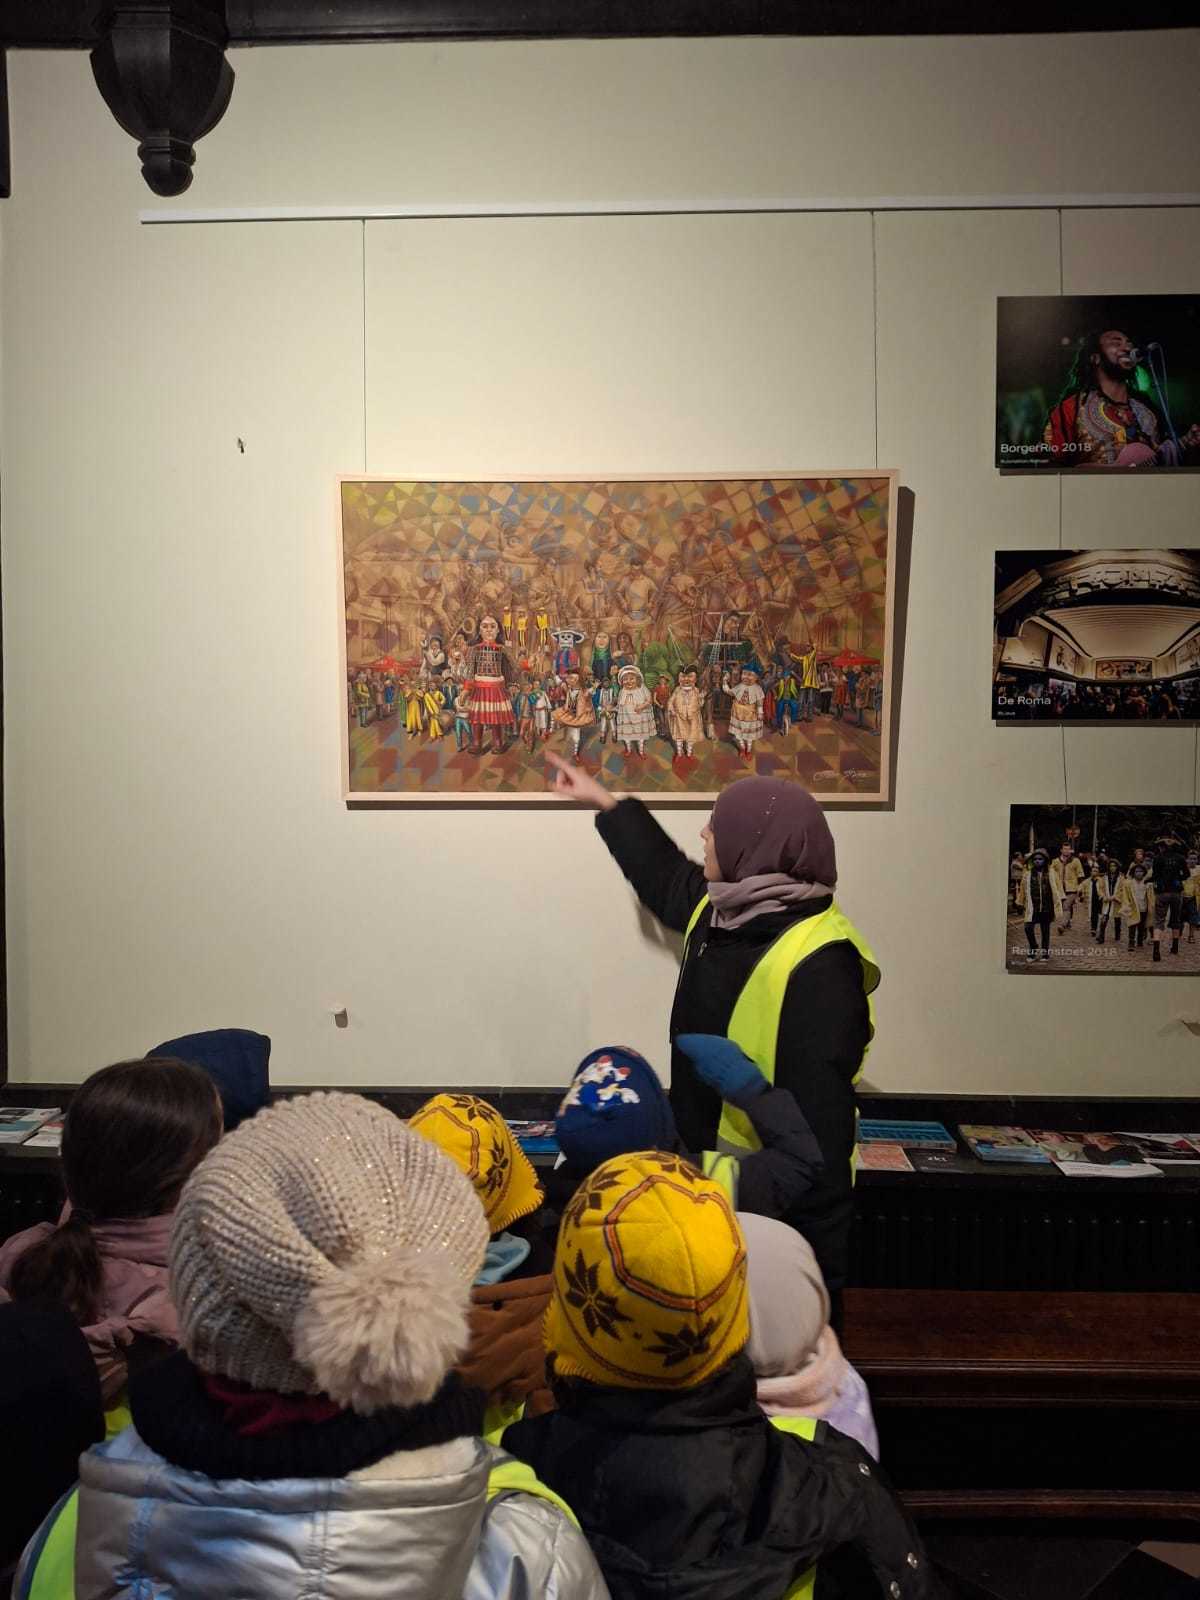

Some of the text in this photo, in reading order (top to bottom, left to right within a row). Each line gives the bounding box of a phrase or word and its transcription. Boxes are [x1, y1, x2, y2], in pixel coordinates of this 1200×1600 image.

[1000, 442, 1092, 455] BorgerRio 2018
[998, 695, 1051, 705] De Roma
